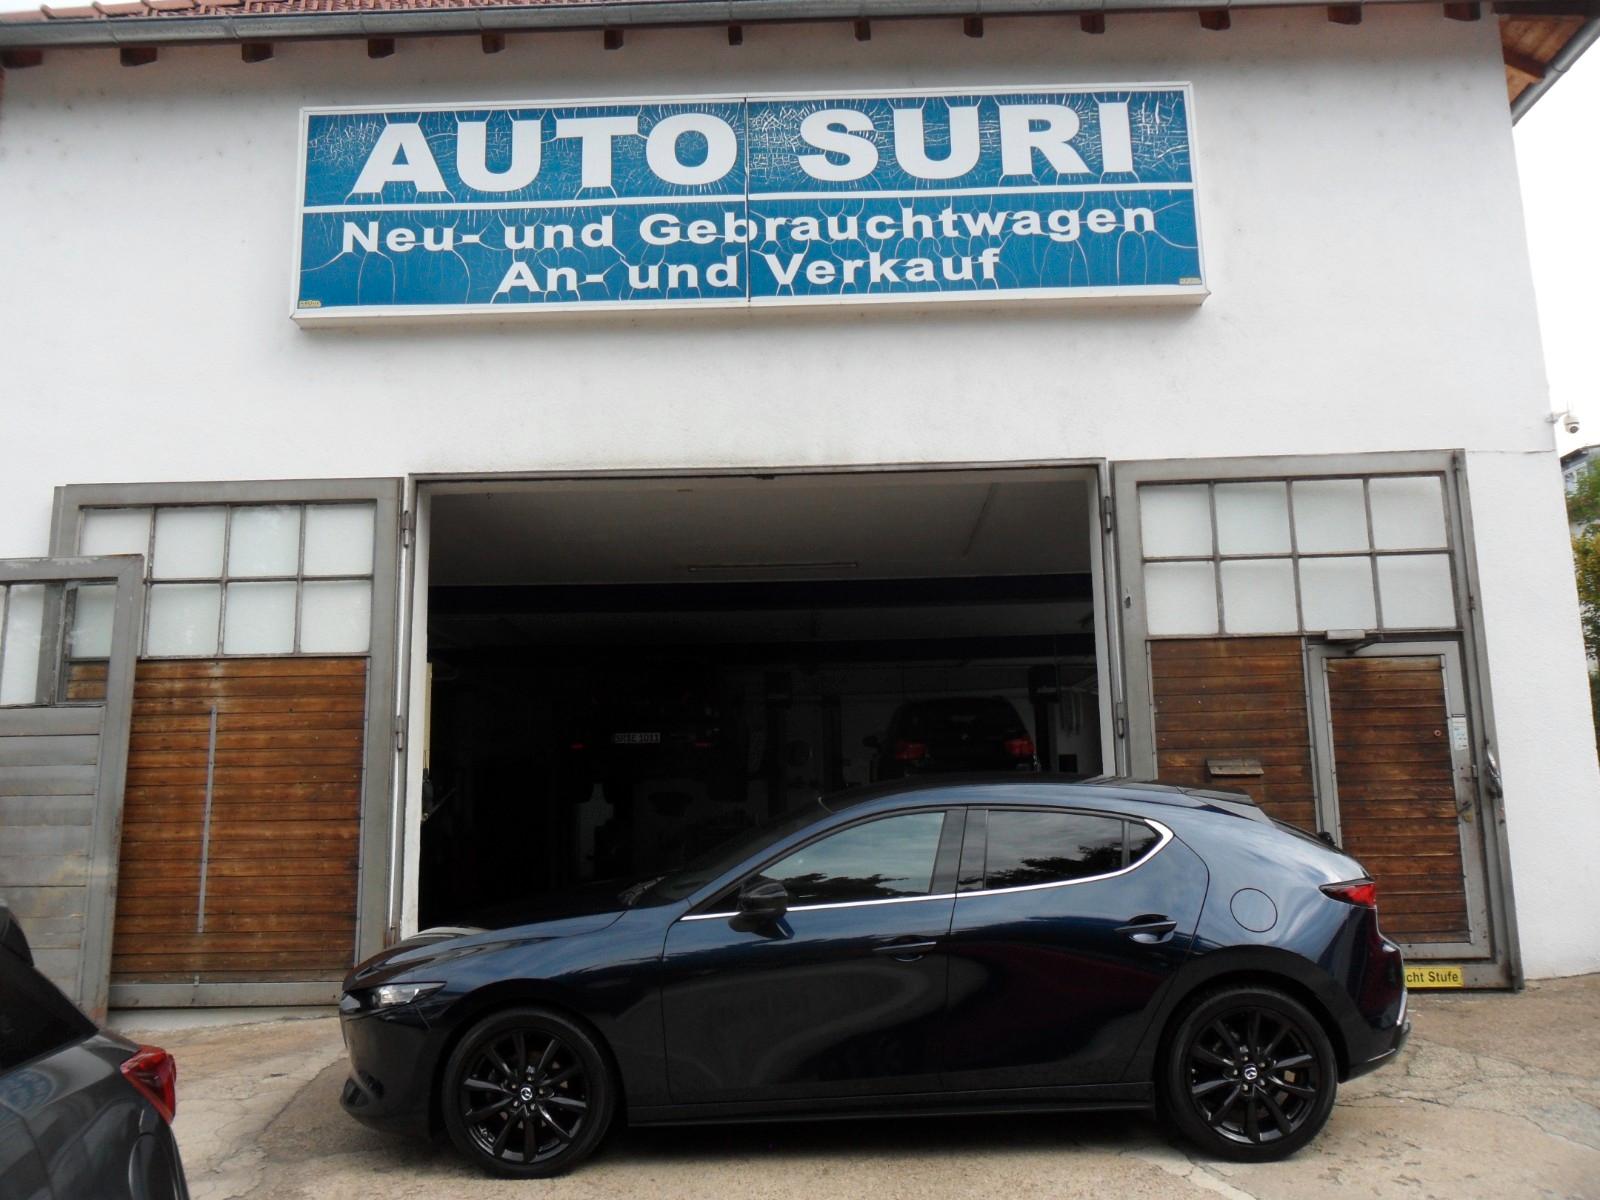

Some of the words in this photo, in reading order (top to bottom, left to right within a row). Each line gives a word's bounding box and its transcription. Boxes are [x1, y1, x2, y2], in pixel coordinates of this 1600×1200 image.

[351, 113, 738, 193] AUTO
[798, 101, 1134, 181] SURI
[342, 220, 481, 253] Neu-
[505, 216, 613, 250] und
[639, 206, 1155, 246] Gebrauchtwagen
[498, 261, 605, 293] An-
[628, 255, 738, 289] und
[764, 247, 1000, 285] Verkauf
[1405, 972, 1424, 983] cht
[1428, 971, 1458, 982] Stufe
